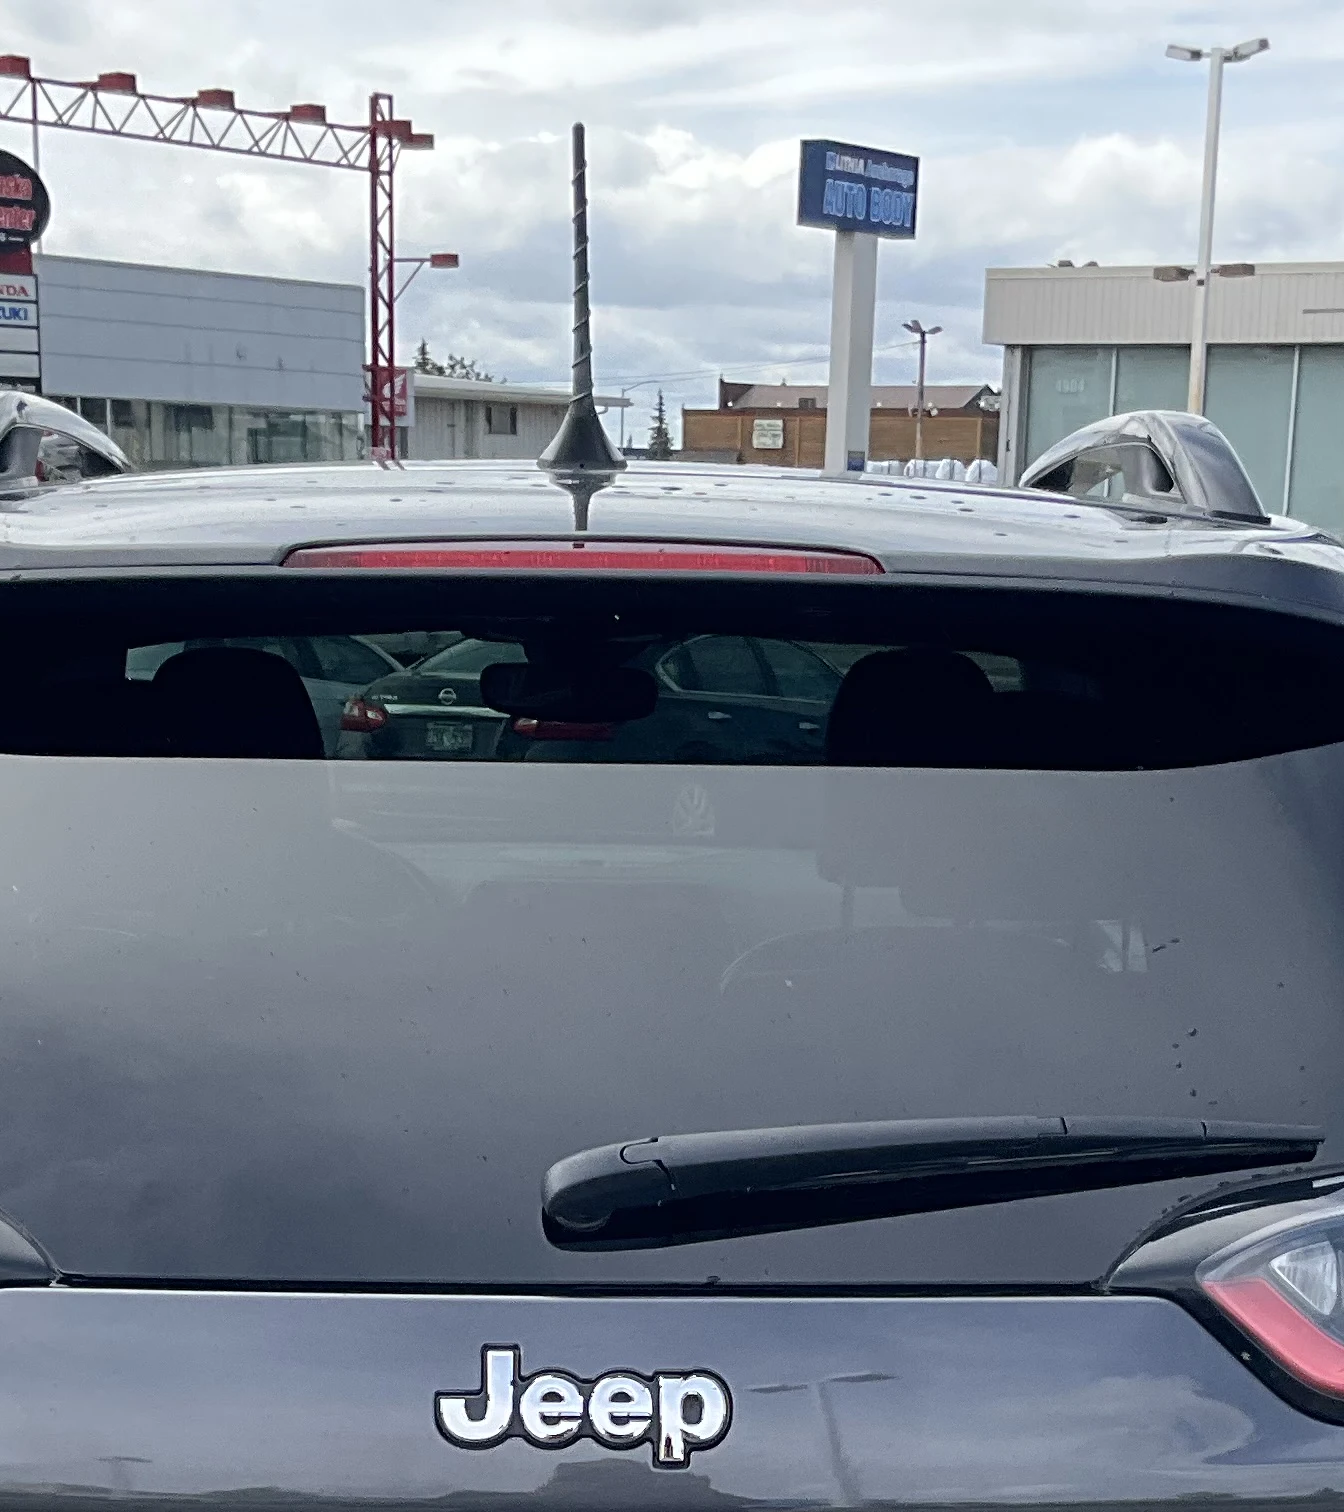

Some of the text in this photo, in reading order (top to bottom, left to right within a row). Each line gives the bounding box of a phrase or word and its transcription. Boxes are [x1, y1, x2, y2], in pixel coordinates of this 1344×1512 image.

[822, 178, 914, 227] AUTO BODY
[437, 1346, 730, 1467] Jeep
